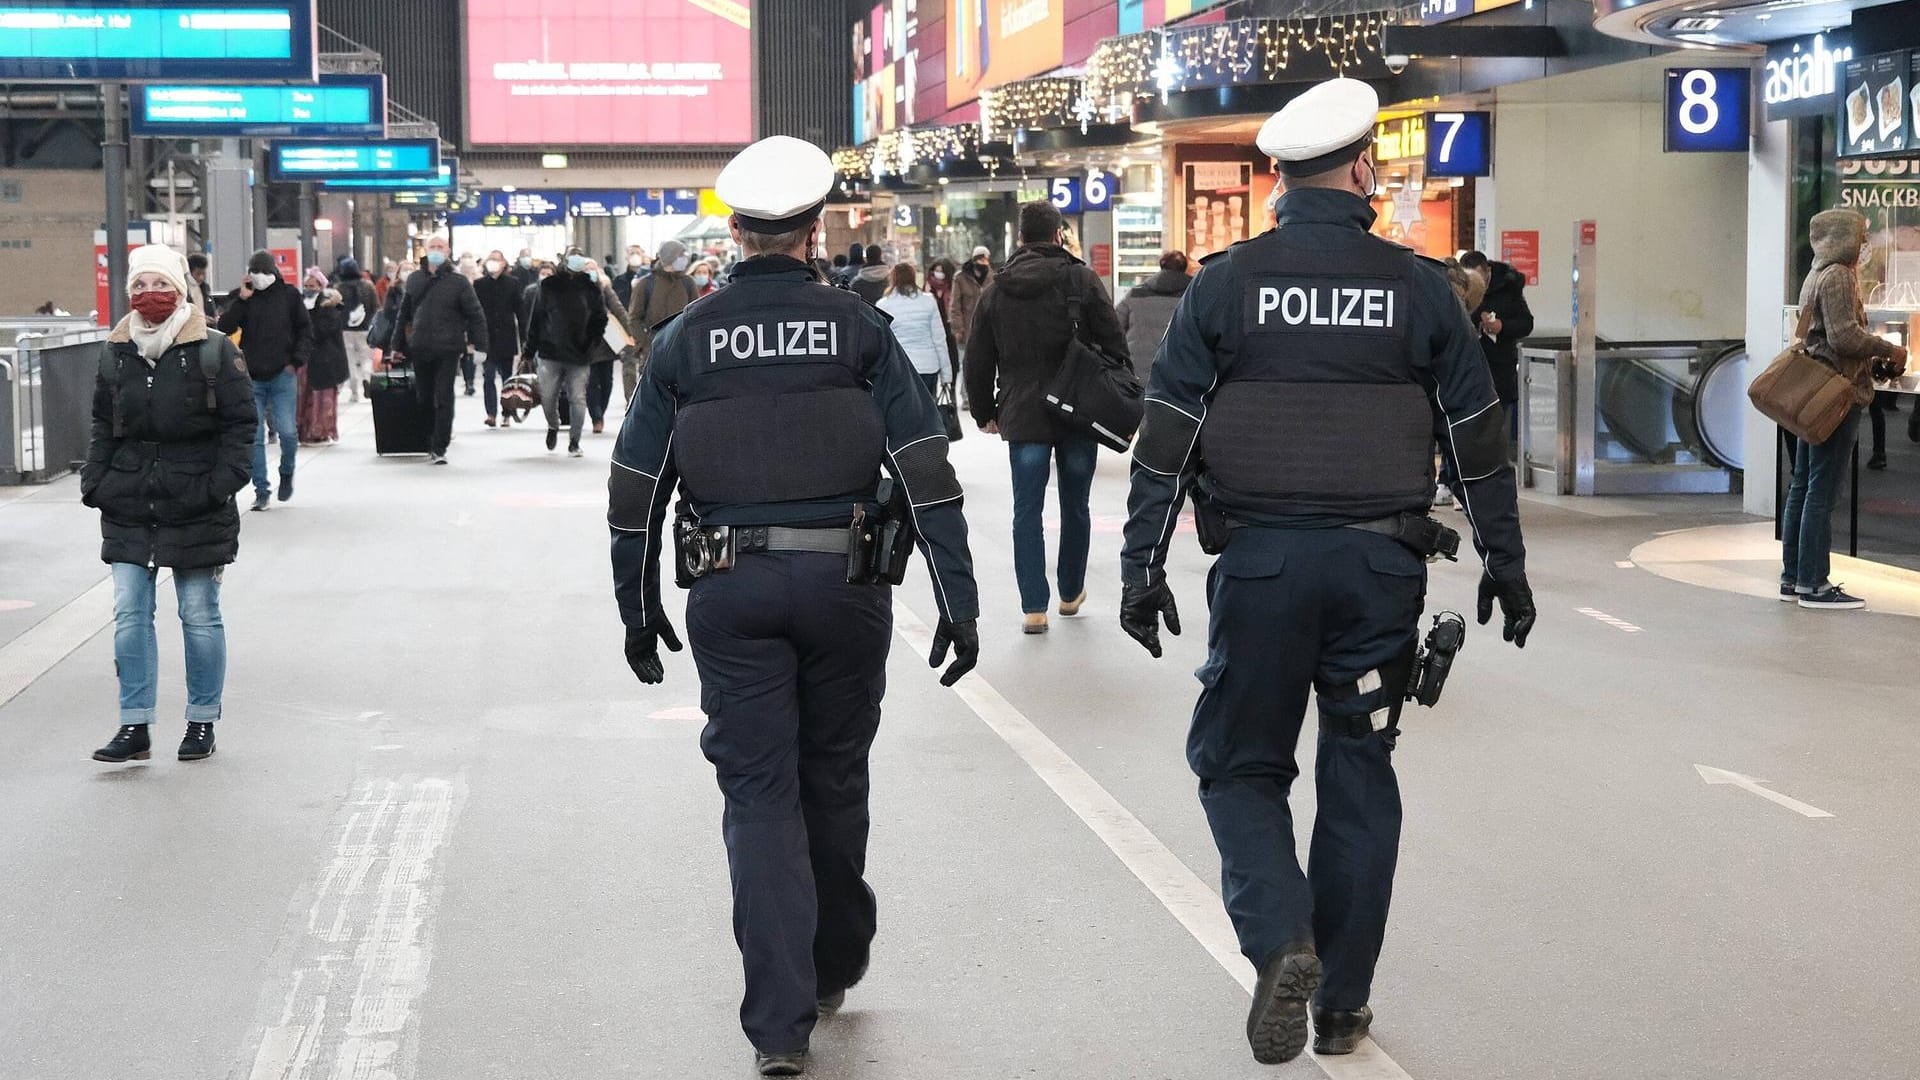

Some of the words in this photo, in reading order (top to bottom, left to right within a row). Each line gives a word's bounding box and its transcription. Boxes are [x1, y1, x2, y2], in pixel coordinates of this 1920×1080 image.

[1679, 70, 1718, 133] 8
[1435, 114, 1464, 162] 7
[1052, 178, 1071, 208] 5
[1084, 168, 1106, 204] 6
[897, 205, 912, 227] 3
[1259, 287, 1393, 328] POLIZEI
[709, 321, 837, 363] POLIZEI
